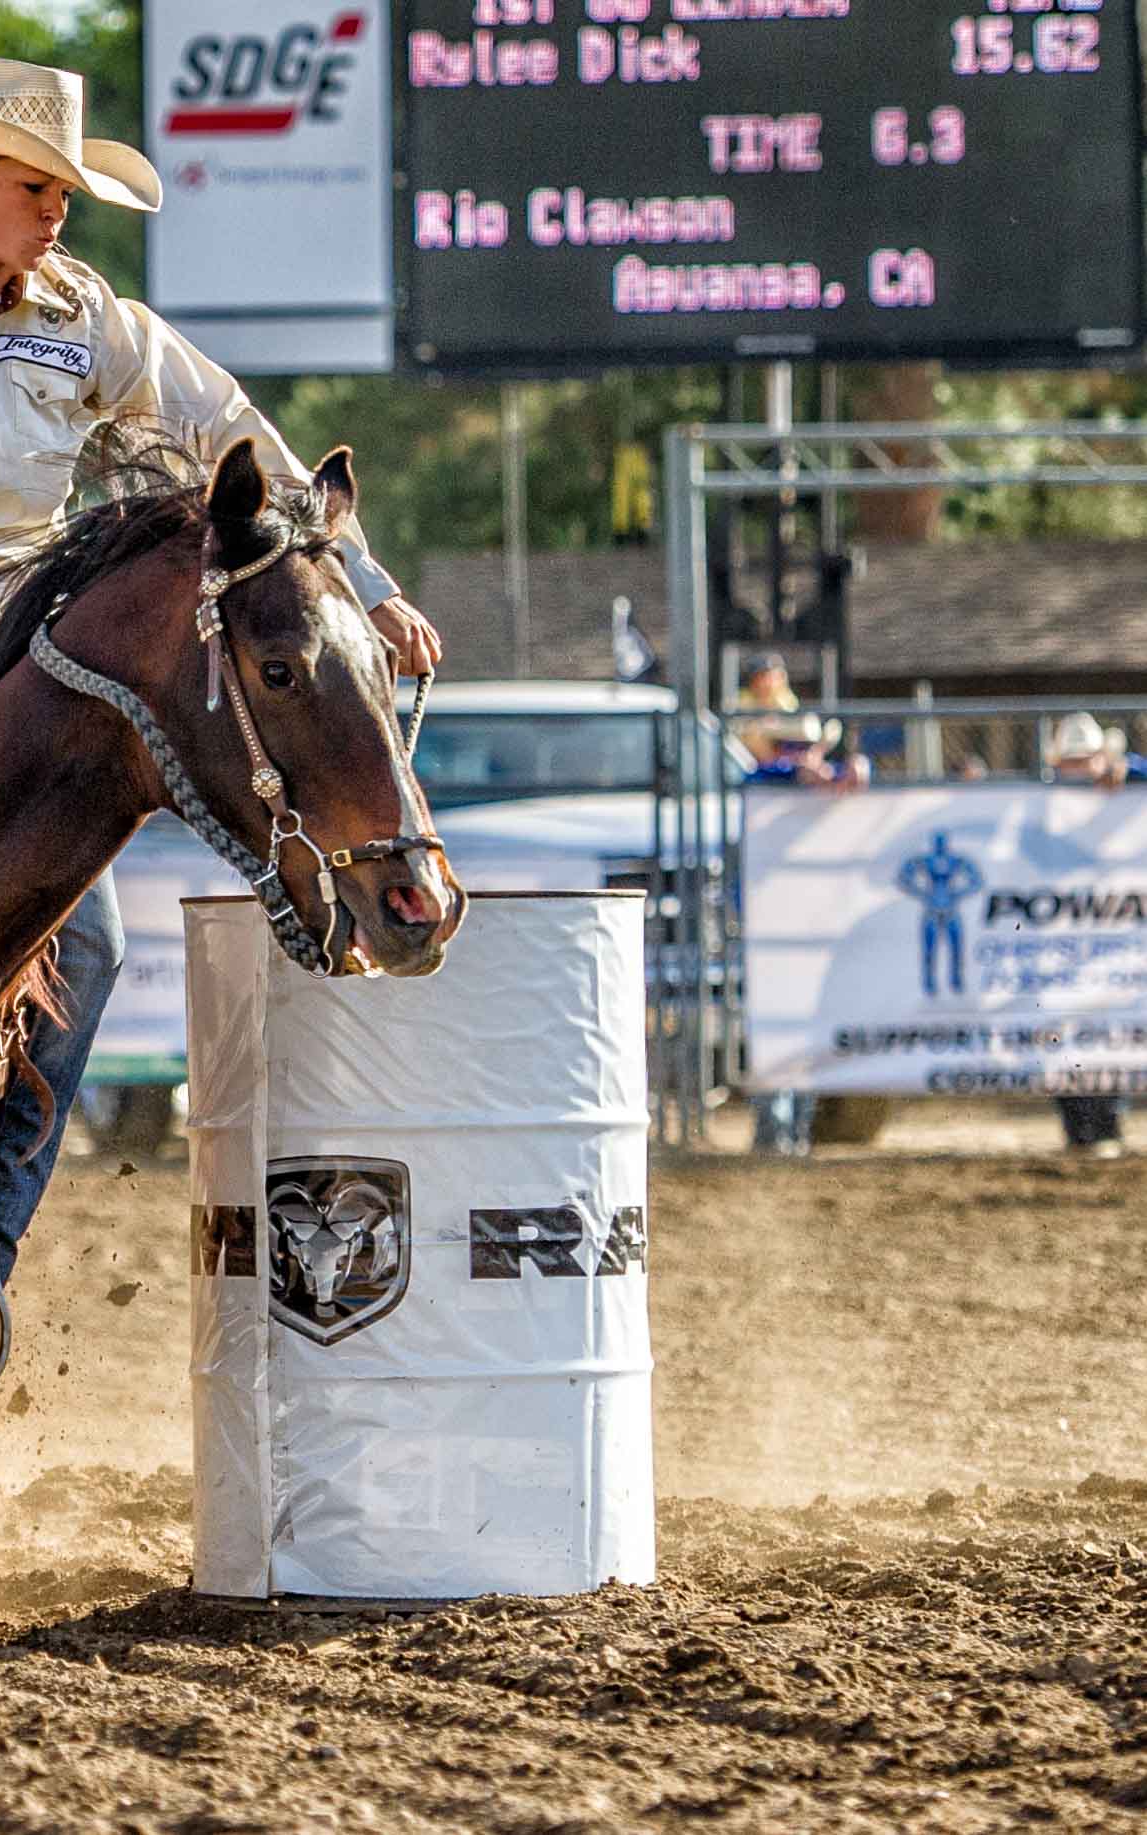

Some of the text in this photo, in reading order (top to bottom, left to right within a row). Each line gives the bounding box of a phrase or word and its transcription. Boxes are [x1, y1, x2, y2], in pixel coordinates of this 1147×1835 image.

[578, 24, 701, 84] Dick
[951, 13, 1101, 74] 15.62
[701, 105, 965, 173] TIME 6.3
[415, 186, 735, 248] Rio Clawson
[868, 247, 935, 307] CA
[0, 336, 85, 367] Integrity
